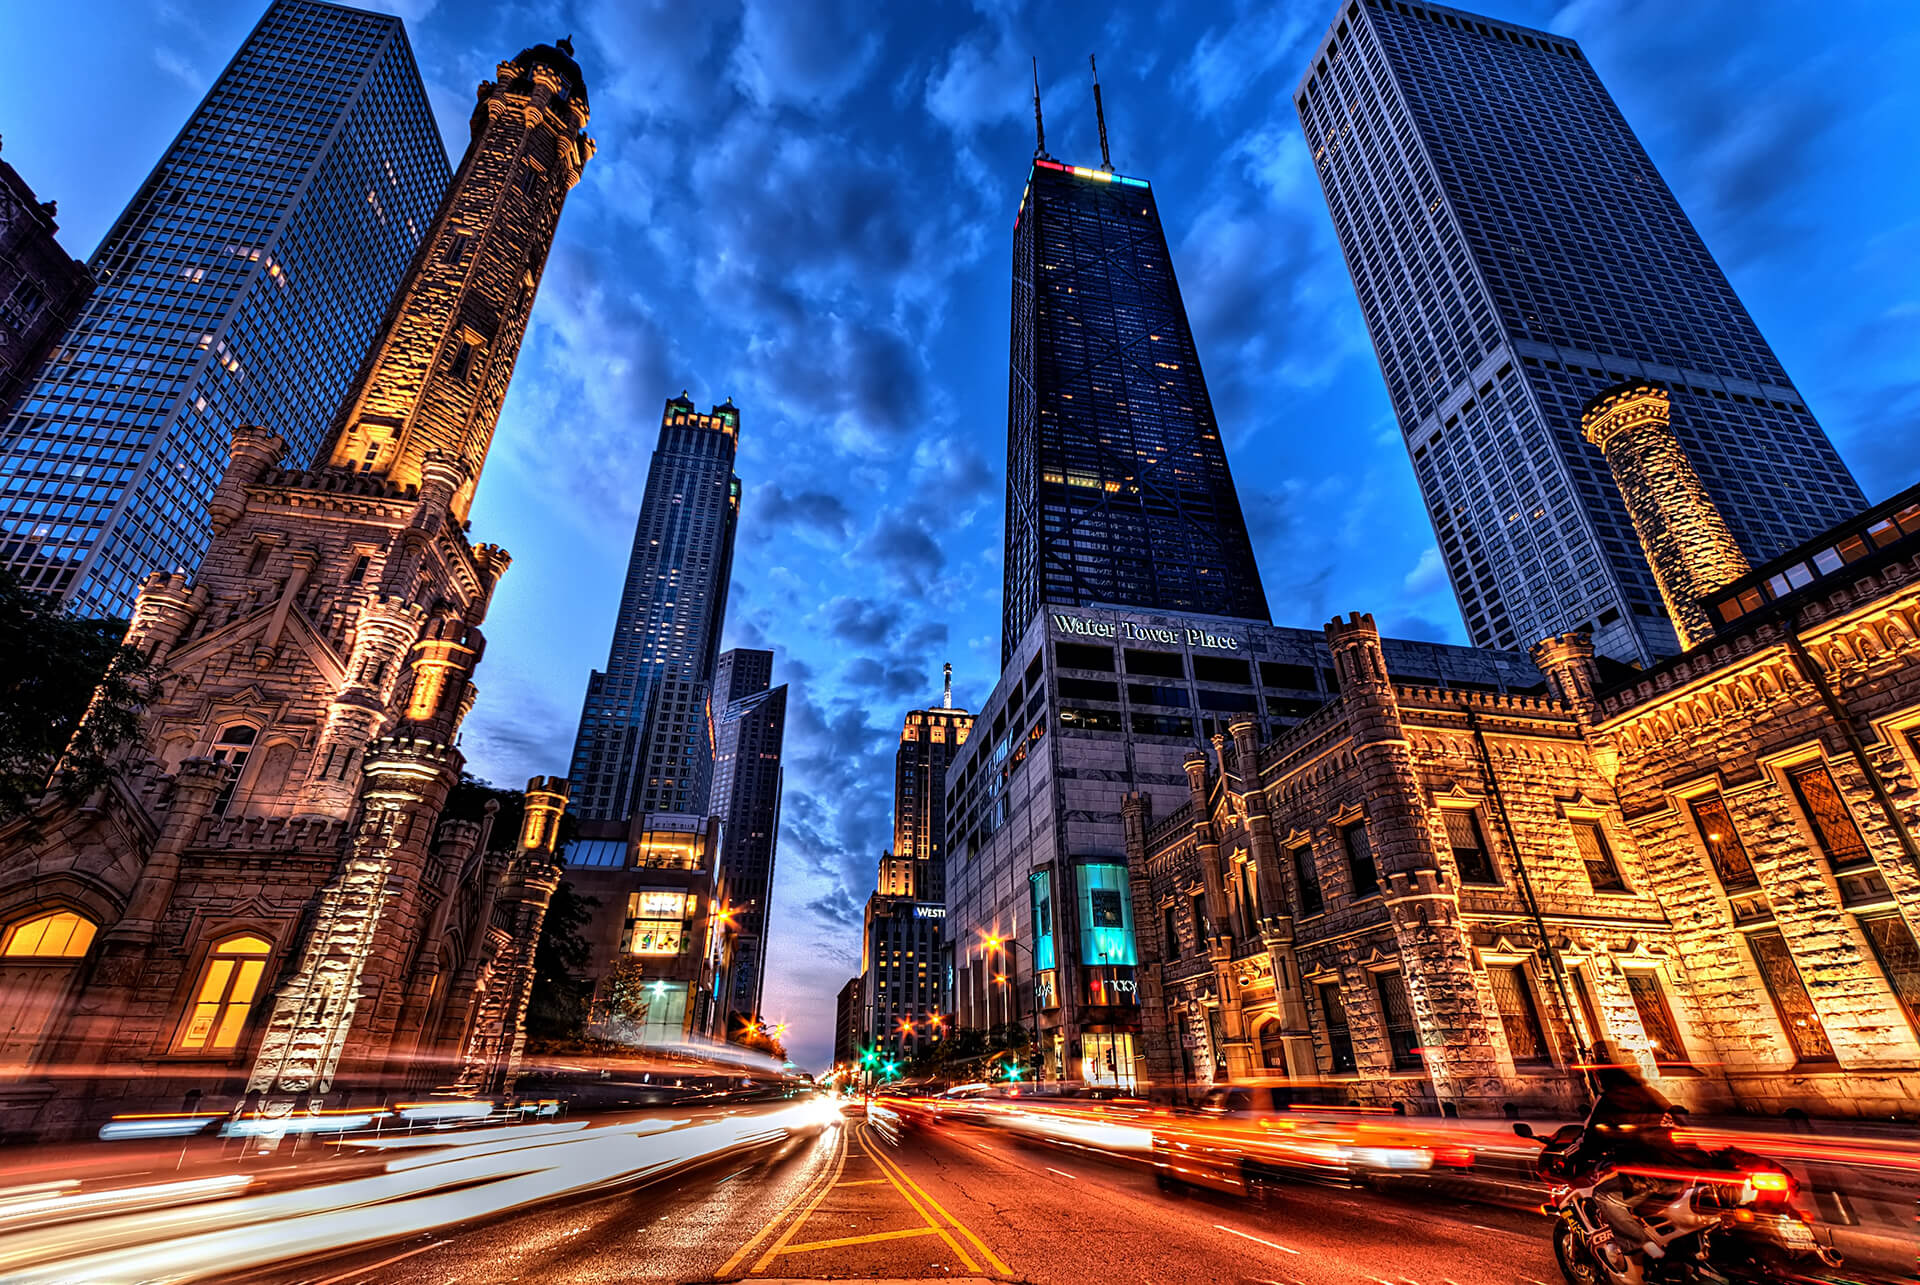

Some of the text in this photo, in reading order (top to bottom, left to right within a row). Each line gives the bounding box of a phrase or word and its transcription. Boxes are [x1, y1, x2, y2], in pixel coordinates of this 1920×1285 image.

[1053, 614, 1238, 650] Water Tower Place
